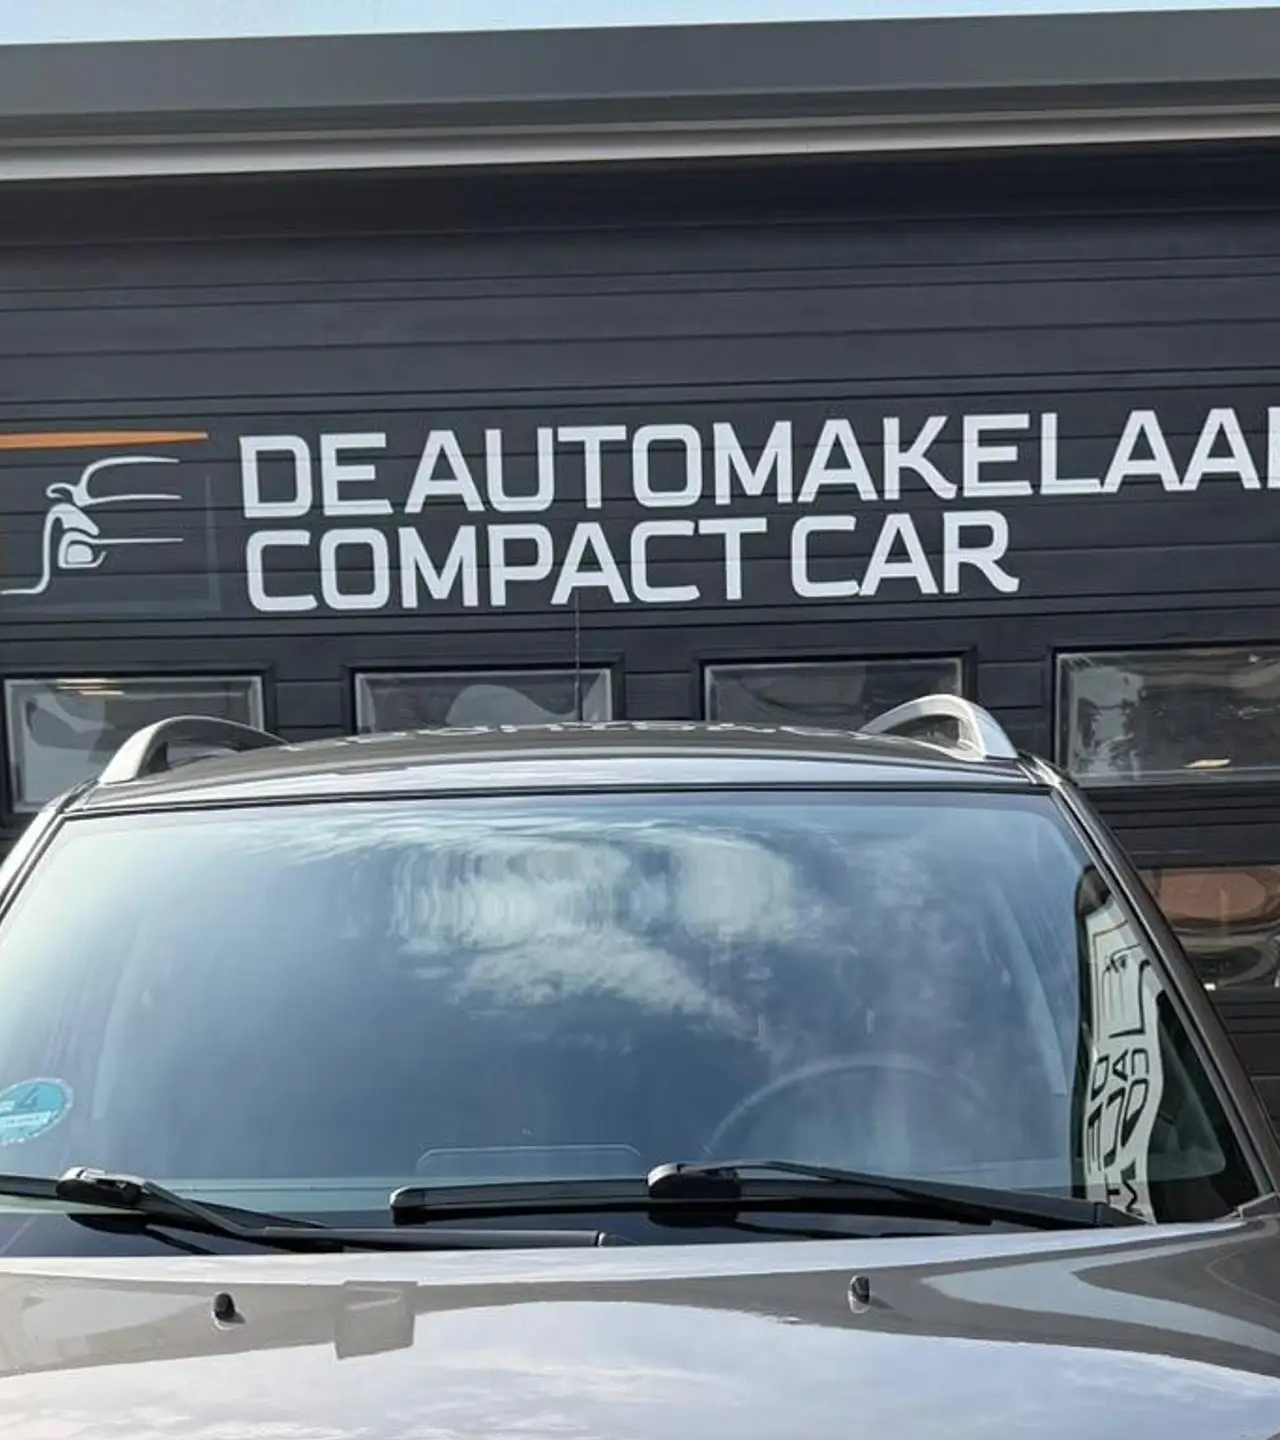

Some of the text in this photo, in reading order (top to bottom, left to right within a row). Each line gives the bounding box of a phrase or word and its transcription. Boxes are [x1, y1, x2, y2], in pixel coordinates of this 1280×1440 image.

[239, 434, 393, 519] DE
[245, 509, 1020, 612] COMPACT CAR
